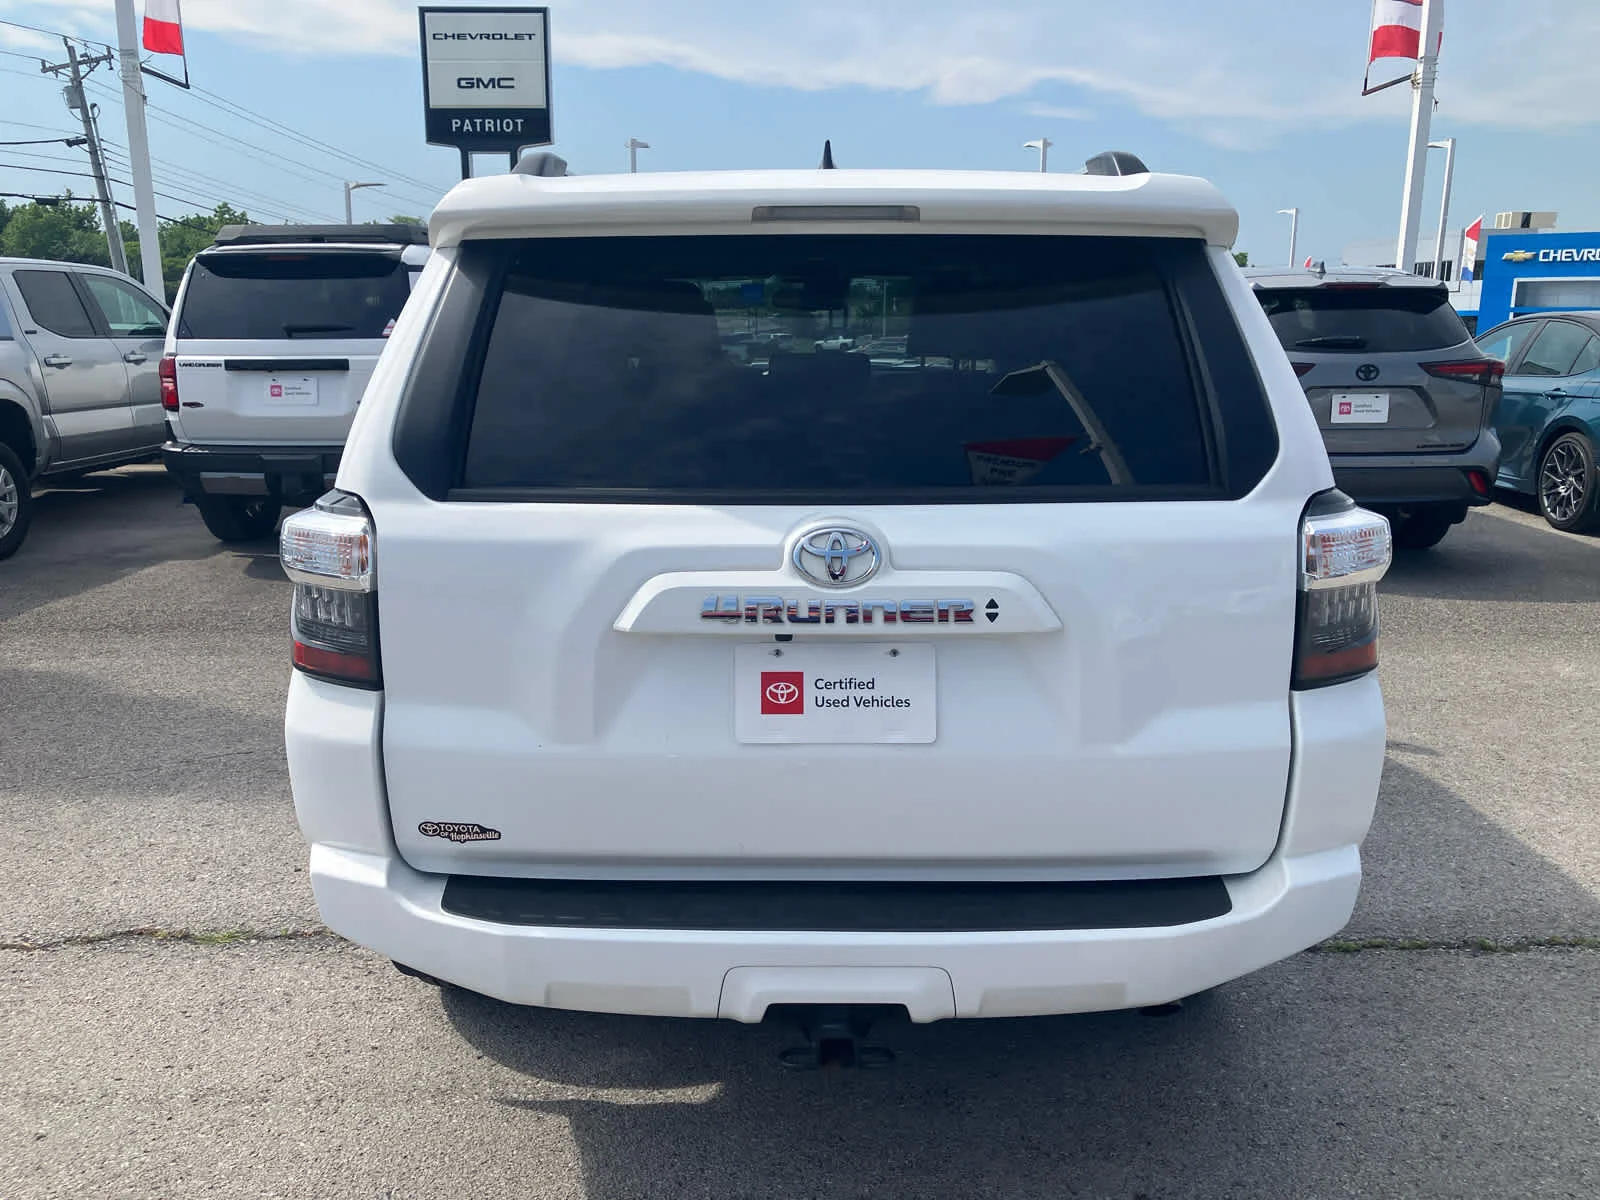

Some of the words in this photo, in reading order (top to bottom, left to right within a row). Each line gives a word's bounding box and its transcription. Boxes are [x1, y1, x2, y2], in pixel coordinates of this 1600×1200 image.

[432, 32, 536, 41] CHEVROLET
[457, 77, 515, 89] GMC
[451, 118, 525, 133] PATRIOT
[814, 677, 875, 690] Certified
[815, 695, 850, 708] Used
[853, 695, 911, 708] Vehicles
[439, 824, 480, 833] TOYOTA
